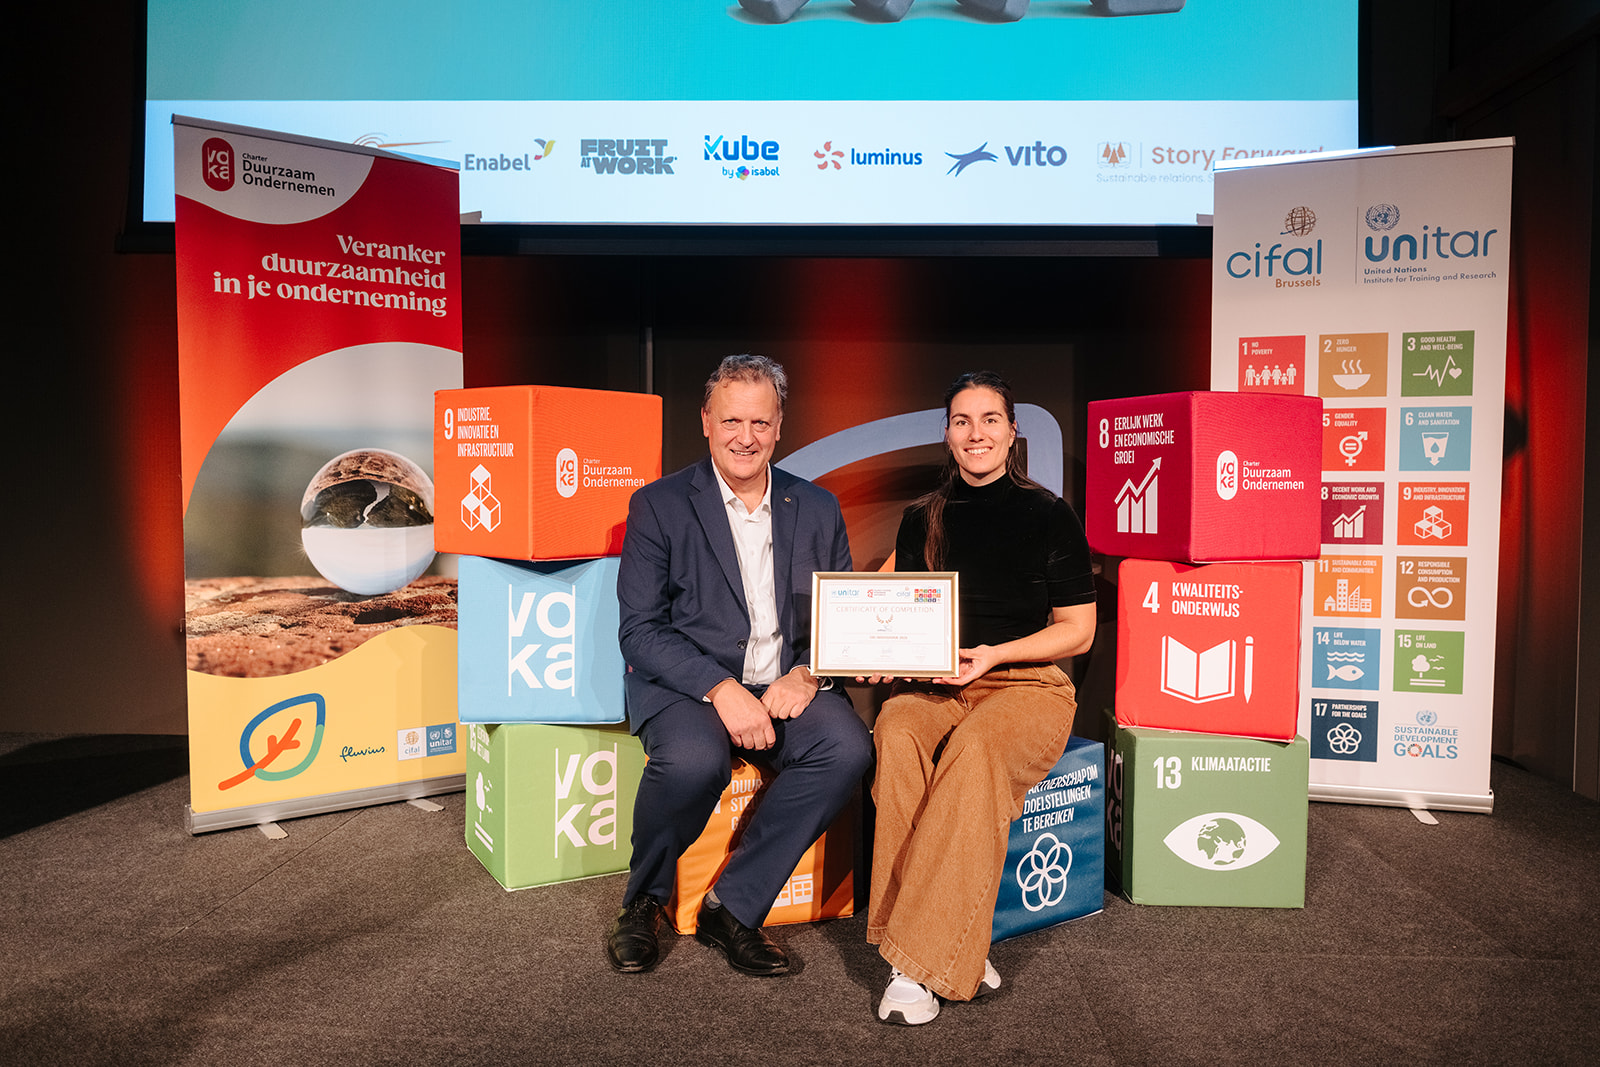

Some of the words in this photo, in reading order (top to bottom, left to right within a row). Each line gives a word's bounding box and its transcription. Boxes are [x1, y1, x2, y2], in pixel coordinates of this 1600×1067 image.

[580, 139, 668, 157] FRUIT
[704, 135, 780, 161] Kube
[851, 147, 923, 165] luminus
[1004, 141, 1068, 167] vito
[242, 152, 268, 162] Charter
[465, 153, 531, 171] Enabel
[1152, 146, 1216, 171] Story
[243, 160, 315, 181] Duurzaam
[580, 156, 592, 168] AT
[592, 156, 675, 175] WORK
[722, 166, 734, 179] by
[751, 165, 780, 177] isabel
[243, 172, 336, 197] Ondernemen
[336, 234, 446, 265] Veranker
[1364, 224, 1498, 262] unitar
[1226, 239, 1323, 279] cifal
[261, 253, 446, 290] duurzaamheid
[1364, 267, 1392, 275] United
[1393, 266, 1427, 274] Nations
[1409, 274, 1441, 283] Training
[1442, 273, 1458, 281] and
[1460, 271, 1497, 280] Research
[1275, 276, 1321, 288] Brussels
[213, 271, 241, 294] in
[247, 275, 271, 300] je
[276, 280, 447, 318] onderneming
[1323, 339, 1332, 353] 2
[1407, 337, 1416, 351] 3
[1436, 335, 1457, 343] HEALTH
[1242, 342, 1248, 355] 1
[457, 406, 492, 422] INDUSTRIE,
[1114, 415, 1142, 431] EERLIJK
[1142, 413, 1164, 428] WERK
[1322, 413, 1330, 427] 5
[1405, 412, 1414, 426] 6
[444, 408, 454, 440] 9
[457, 425, 490, 440] INNOVATIE
[490, 424, 499, 439] EN
[1099, 418, 1110, 449] 8
[1114, 433, 1123, 448] EN
[1123, 430, 1175, 447] ECONOMISCHE
[457, 443, 514, 457] INFRASTRUCTUUR
[1114, 450, 1135, 464] GROEI
[583, 464, 632, 475] Duurzaam
[1242, 466, 1292, 478] Duurzaam
[582, 476, 645, 487] Ondernemen
[1242, 478, 1304, 490] Ondernemen
[1321, 486, 1329, 500] 8
[1403, 486, 1412, 500] 9
[1318, 559, 1329, 573] 11
[1399, 560, 1414, 575] 12
[1142, 581, 1160, 613] 4
[1172, 582, 1244, 599] KWALITEITS-
[1172, 600, 1240, 618] ONDERWIJS
[1316, 631, 1330, 645] 14
[1398, 634, 1412, 648] 15
[1314, 702, 1328, 717] 17
[1394, 726, 1458, 737] SUSTAINABLE
[1394, 734, 1458, 745] DEVELOPMENT
[429, 739, 453, 748] unitar
[340, 745, 386, 762] fluvius
[1191, 756, 1272, 773] KLIMAATACTIE
[1028, 768, 1087, 795] ARTNERSCHAP
[1086, 764, 1098, 781] OM
[1153, 756, 1182, 790] 13
[1023, 784, 1092, 815] DOELSTELLINGEN
[1022, 817, 1033, 834] TE
[1033, 807, 1075, 831] BEREIKEN
